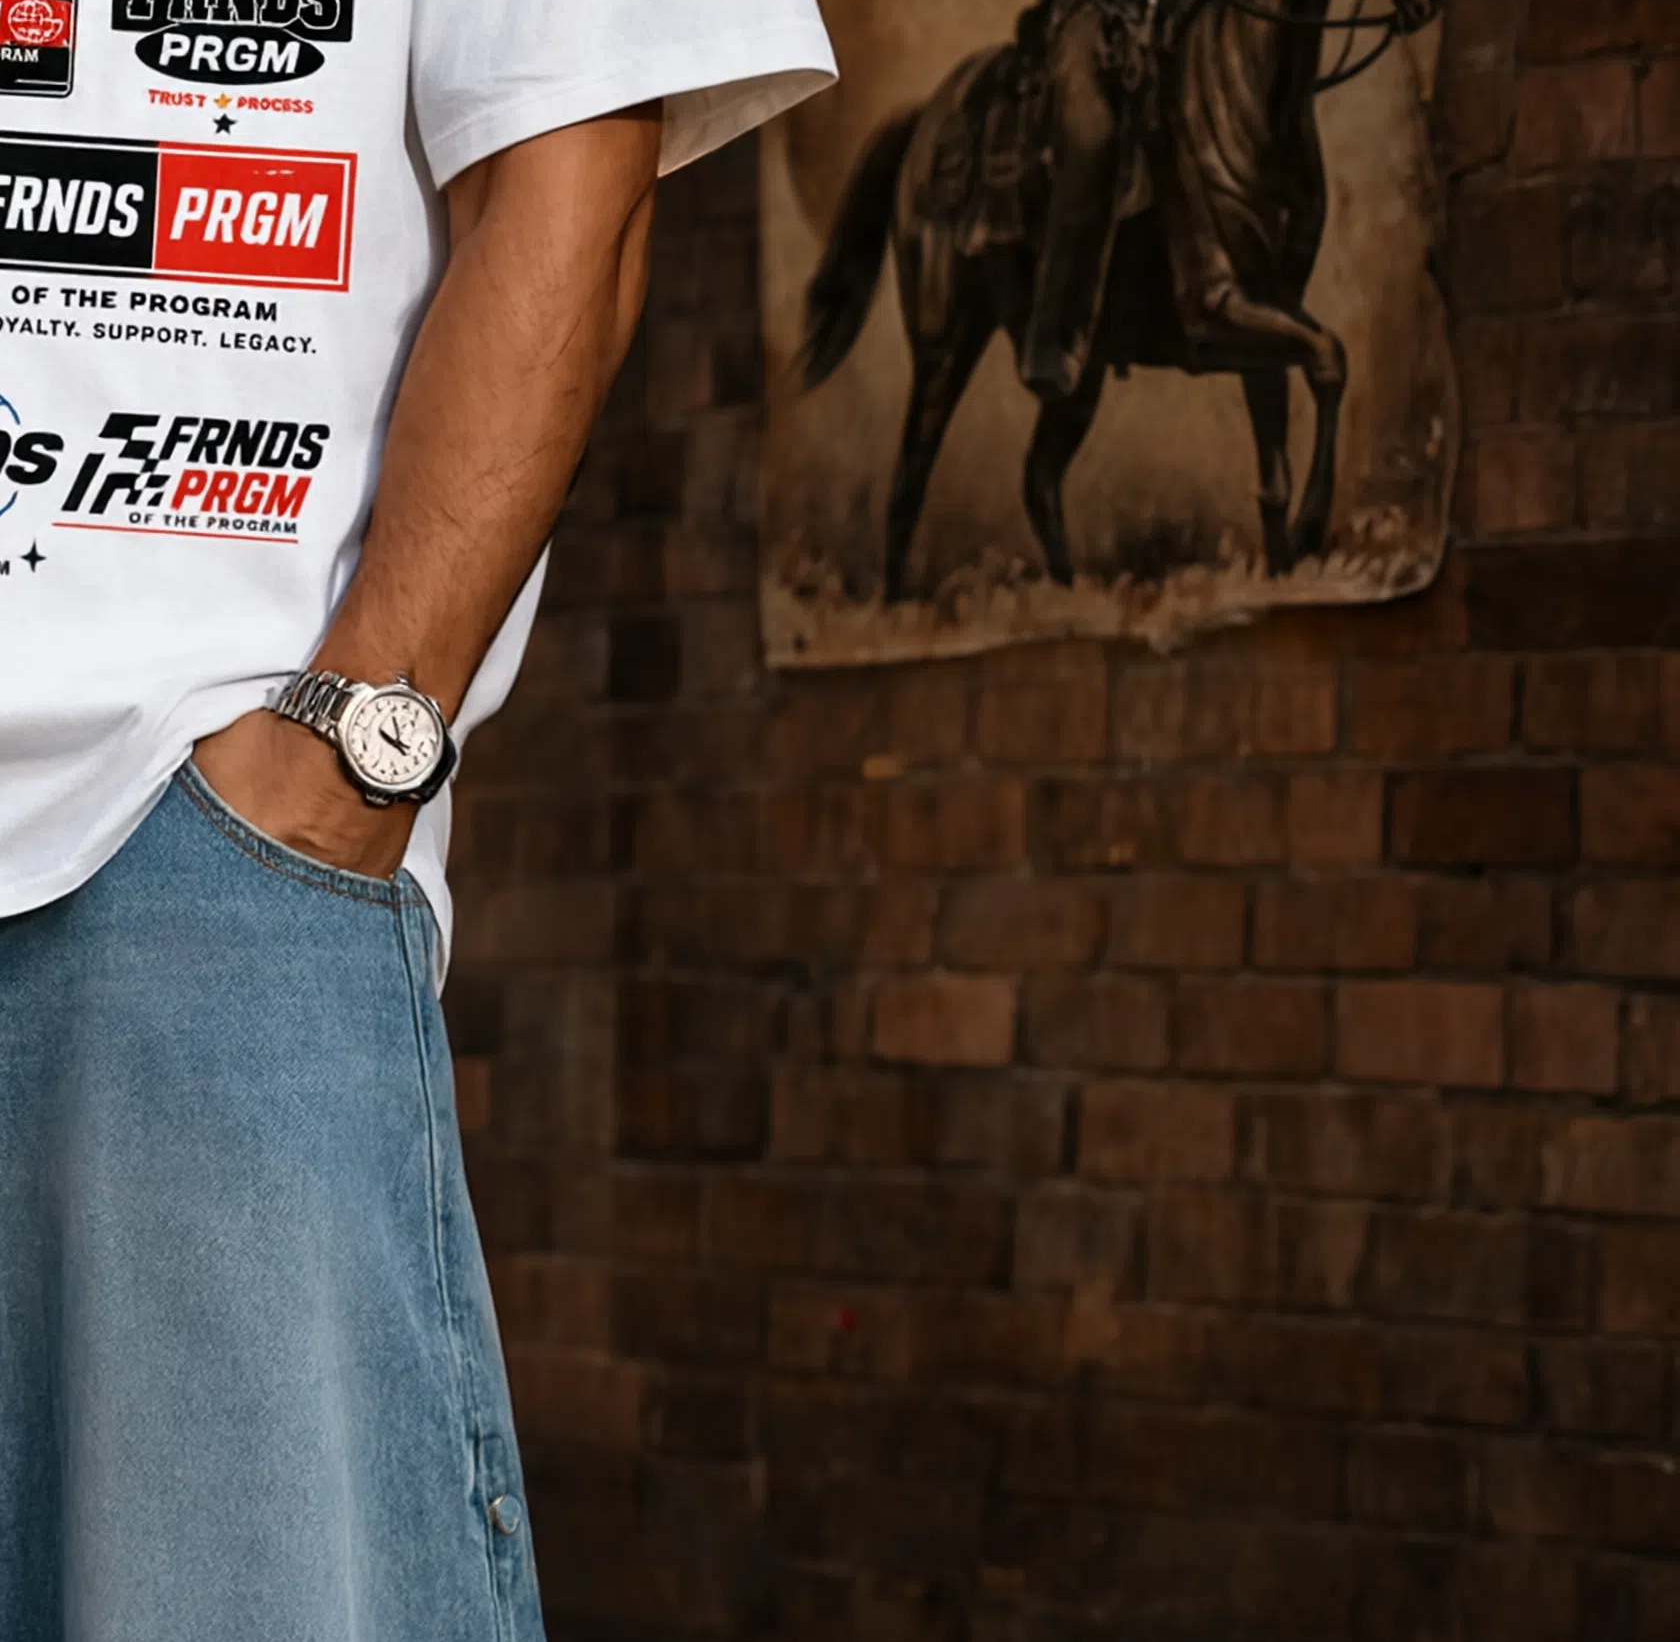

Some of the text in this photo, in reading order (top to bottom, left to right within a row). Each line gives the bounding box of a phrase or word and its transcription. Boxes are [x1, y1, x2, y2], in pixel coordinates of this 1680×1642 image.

[159, 33, 300, 74] PRGM
[148, 89, 314, 114] TRUST PROCESS
[169, 187, 328, 248] PRGM
[11, 285, 278, 322] OF THE PROGRAM
[93, 323, 208, 347] SUPPORT.
[220, 333, 317, 354] LEGACY.
[159, 416, 330, 469] FRNDS
[170, 469, 312, 518] PRGM
[129, 512, 297, 534] OF THE PROGRAM
